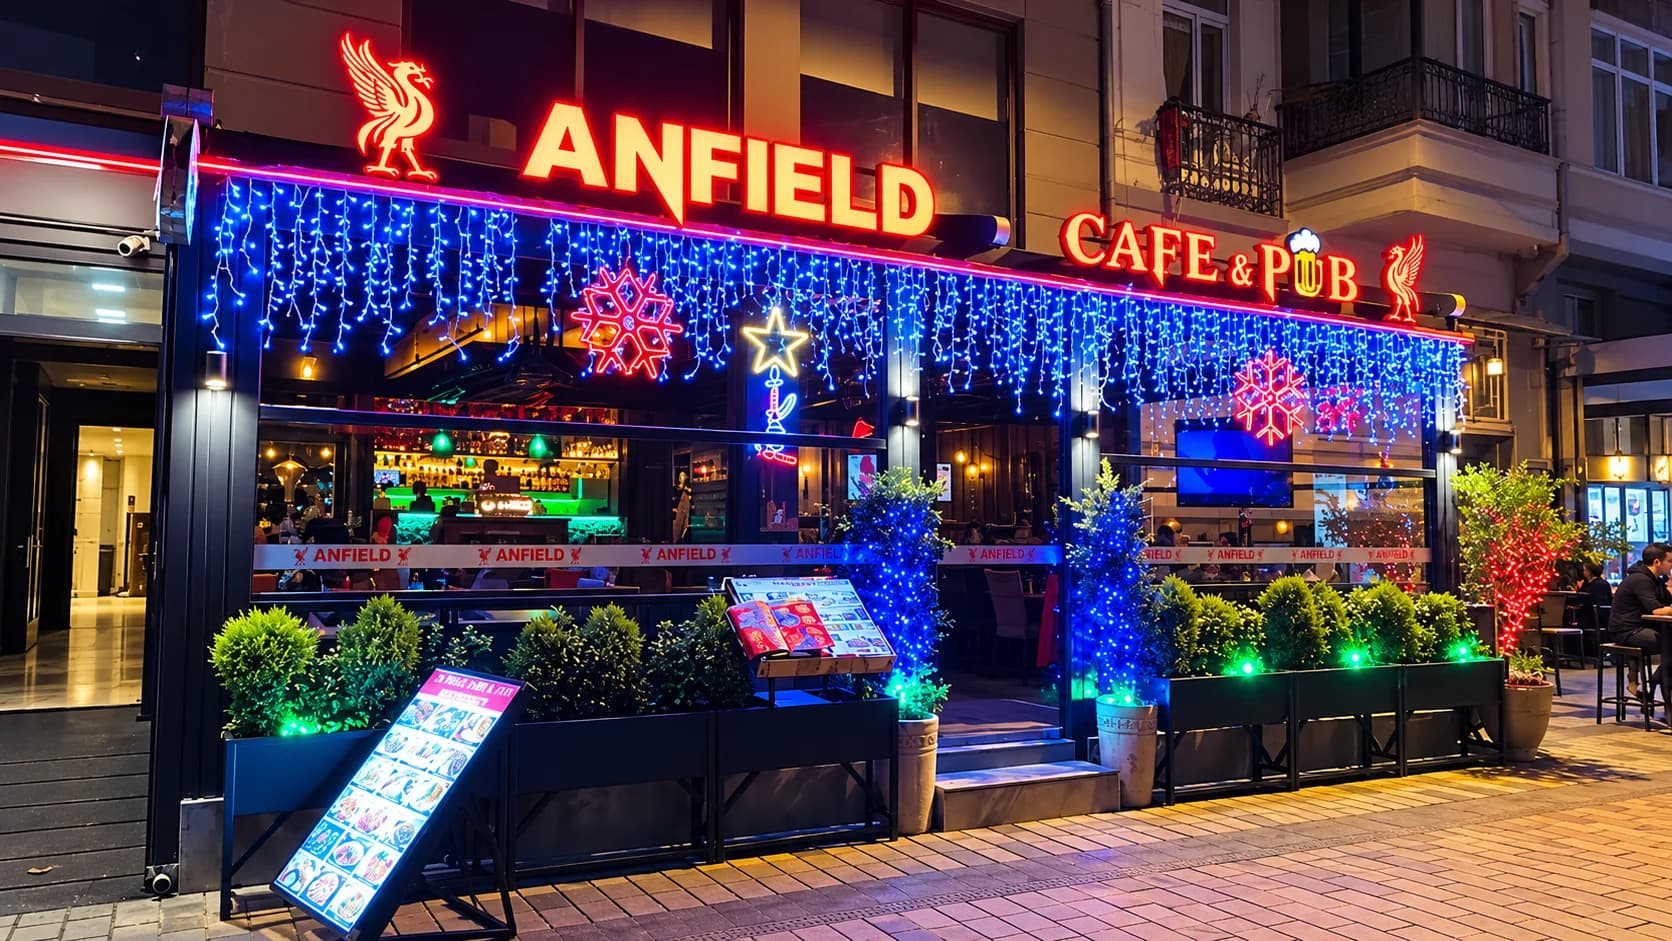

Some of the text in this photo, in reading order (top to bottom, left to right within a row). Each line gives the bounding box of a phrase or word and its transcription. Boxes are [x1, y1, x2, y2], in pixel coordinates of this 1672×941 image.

[521, 101, 936, 237] ANFIELD
[1062, 213, 1360, 303] CAFE & PUB
[313, 548, 392, 562] ANFIELD
[496, 547, 564, 562] ANFIELD
[656, 547, 717, 561] ANFIELD
[981, 547, 1025, 560] ANFIELD
[1217, 549, 1255, 560] ANFIELD
[1301, 550, 1335, 559] ANFIELD
